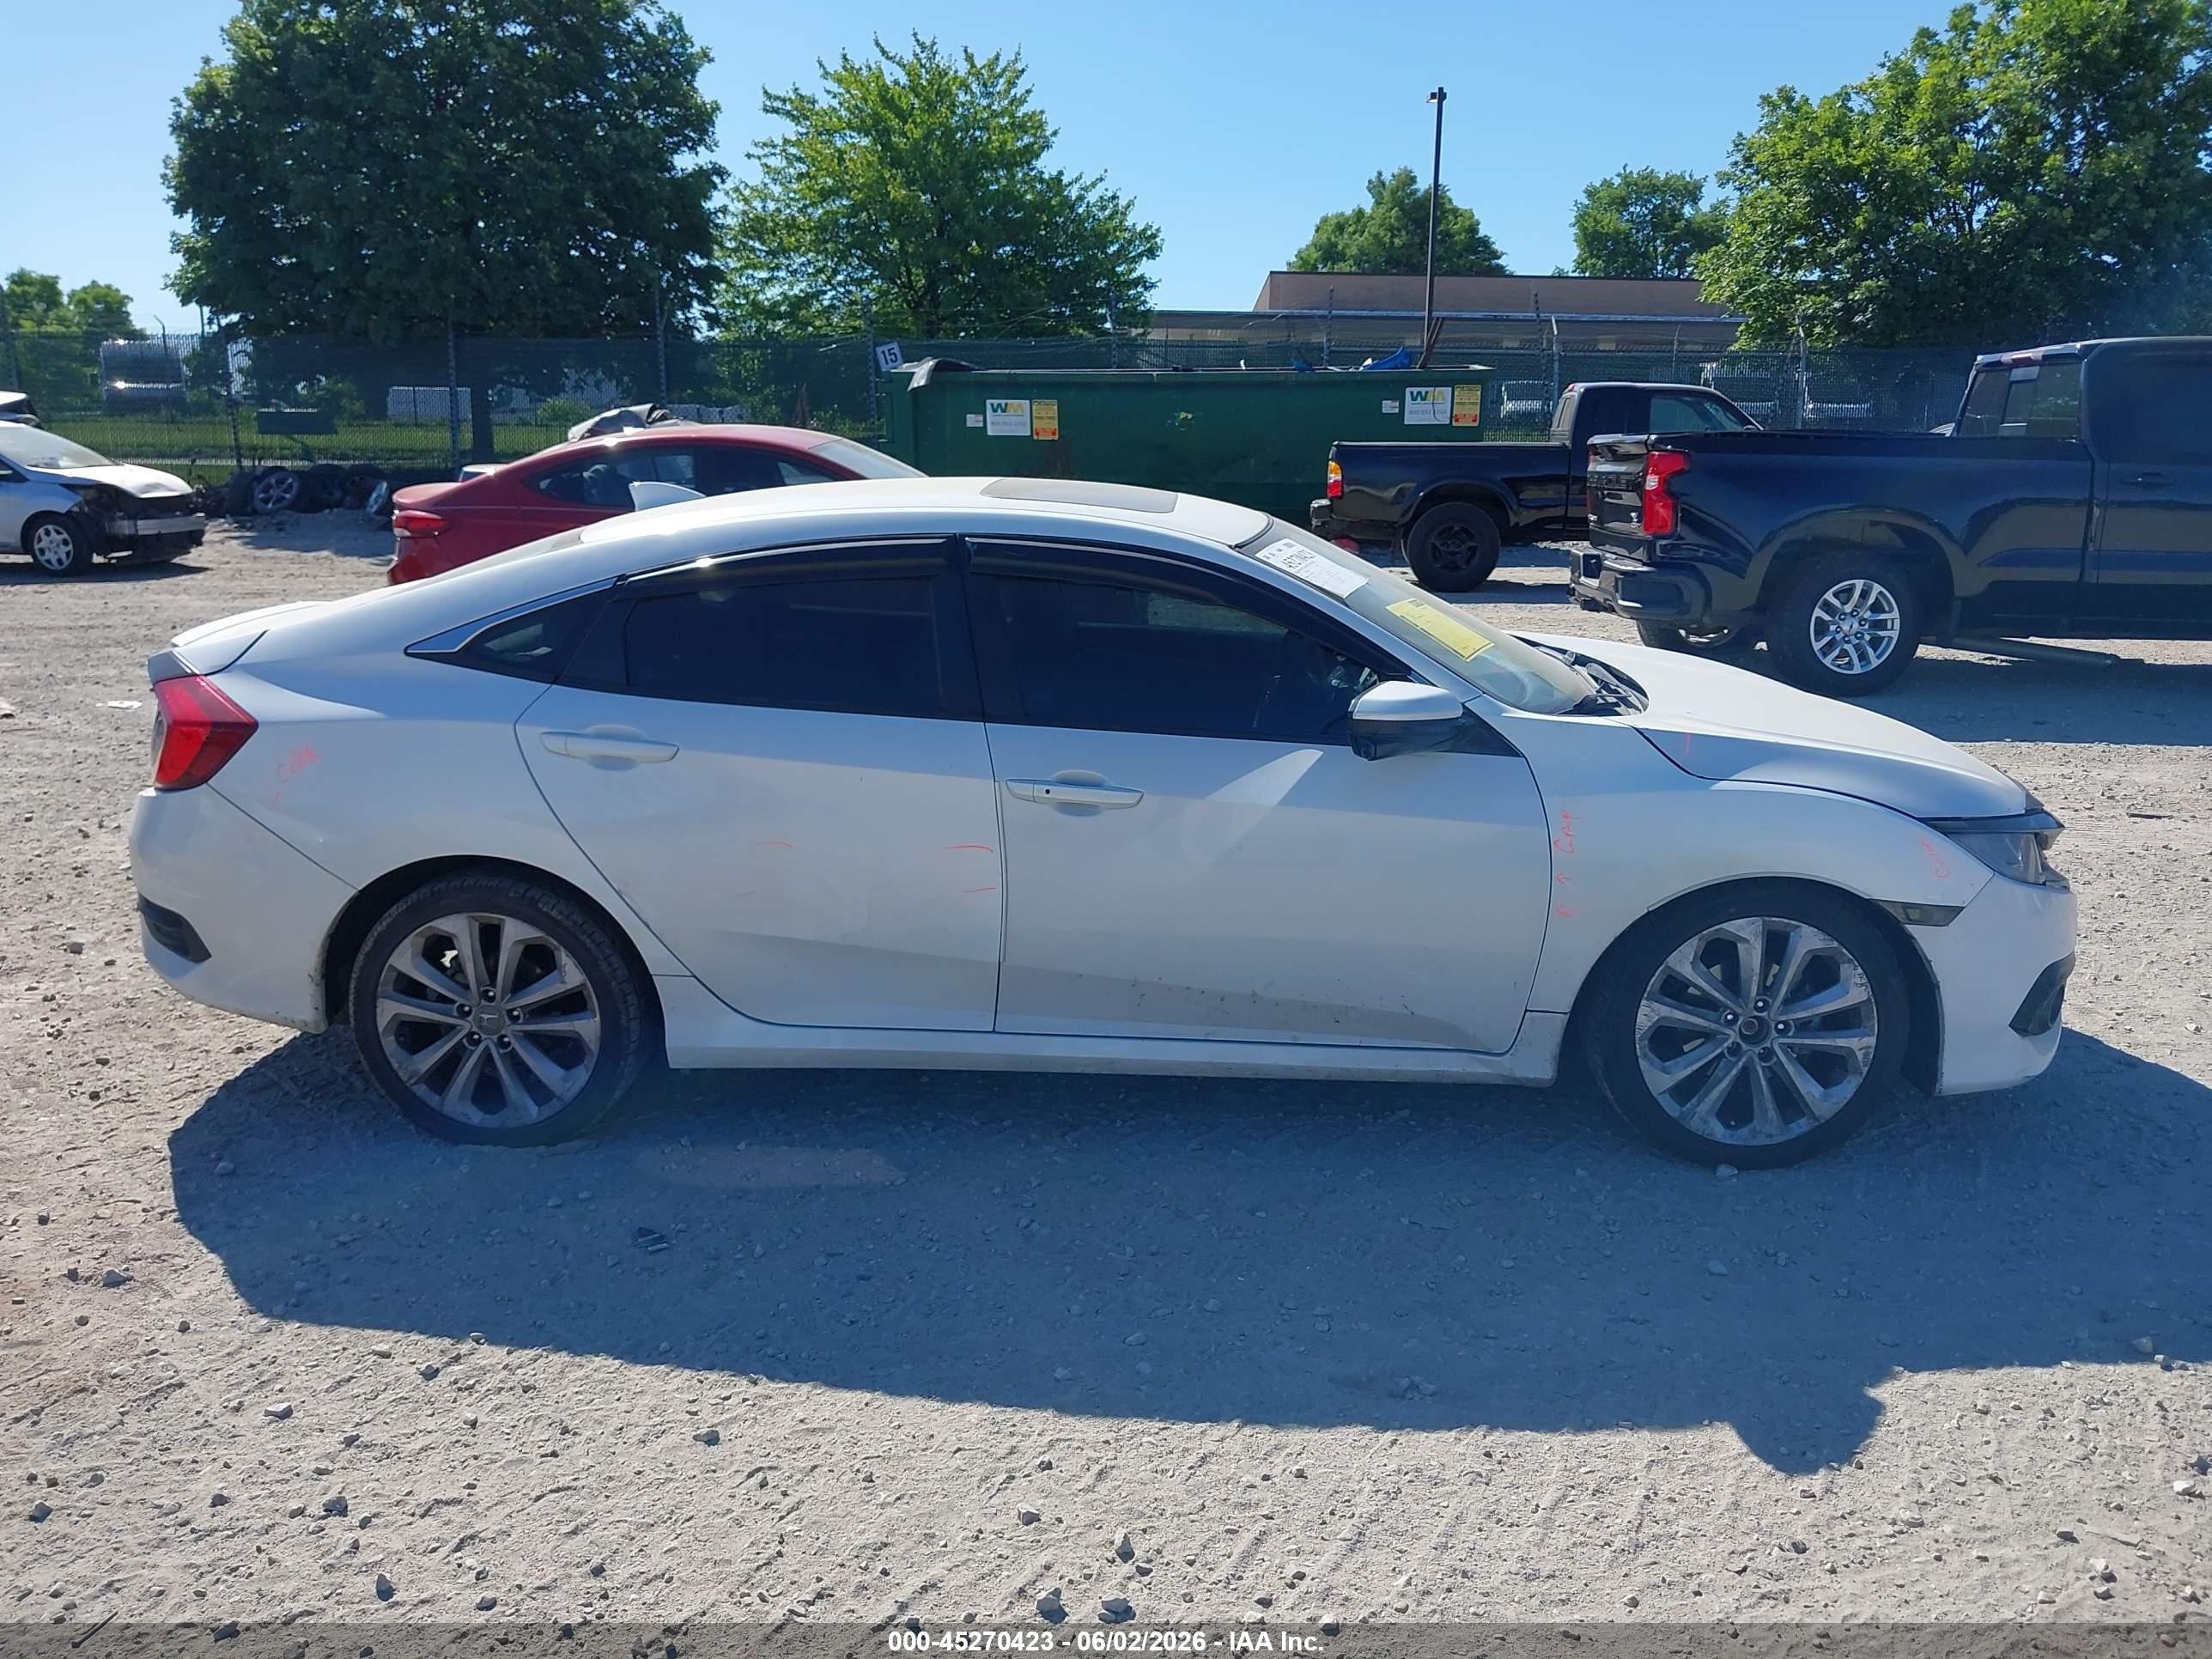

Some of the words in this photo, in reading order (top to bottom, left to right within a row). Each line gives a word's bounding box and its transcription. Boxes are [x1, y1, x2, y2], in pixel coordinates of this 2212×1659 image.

[881, 347, 898, 365] 15
[1410, 390, 1445, 402] WM
[990, 402, 1024, 413] WM
